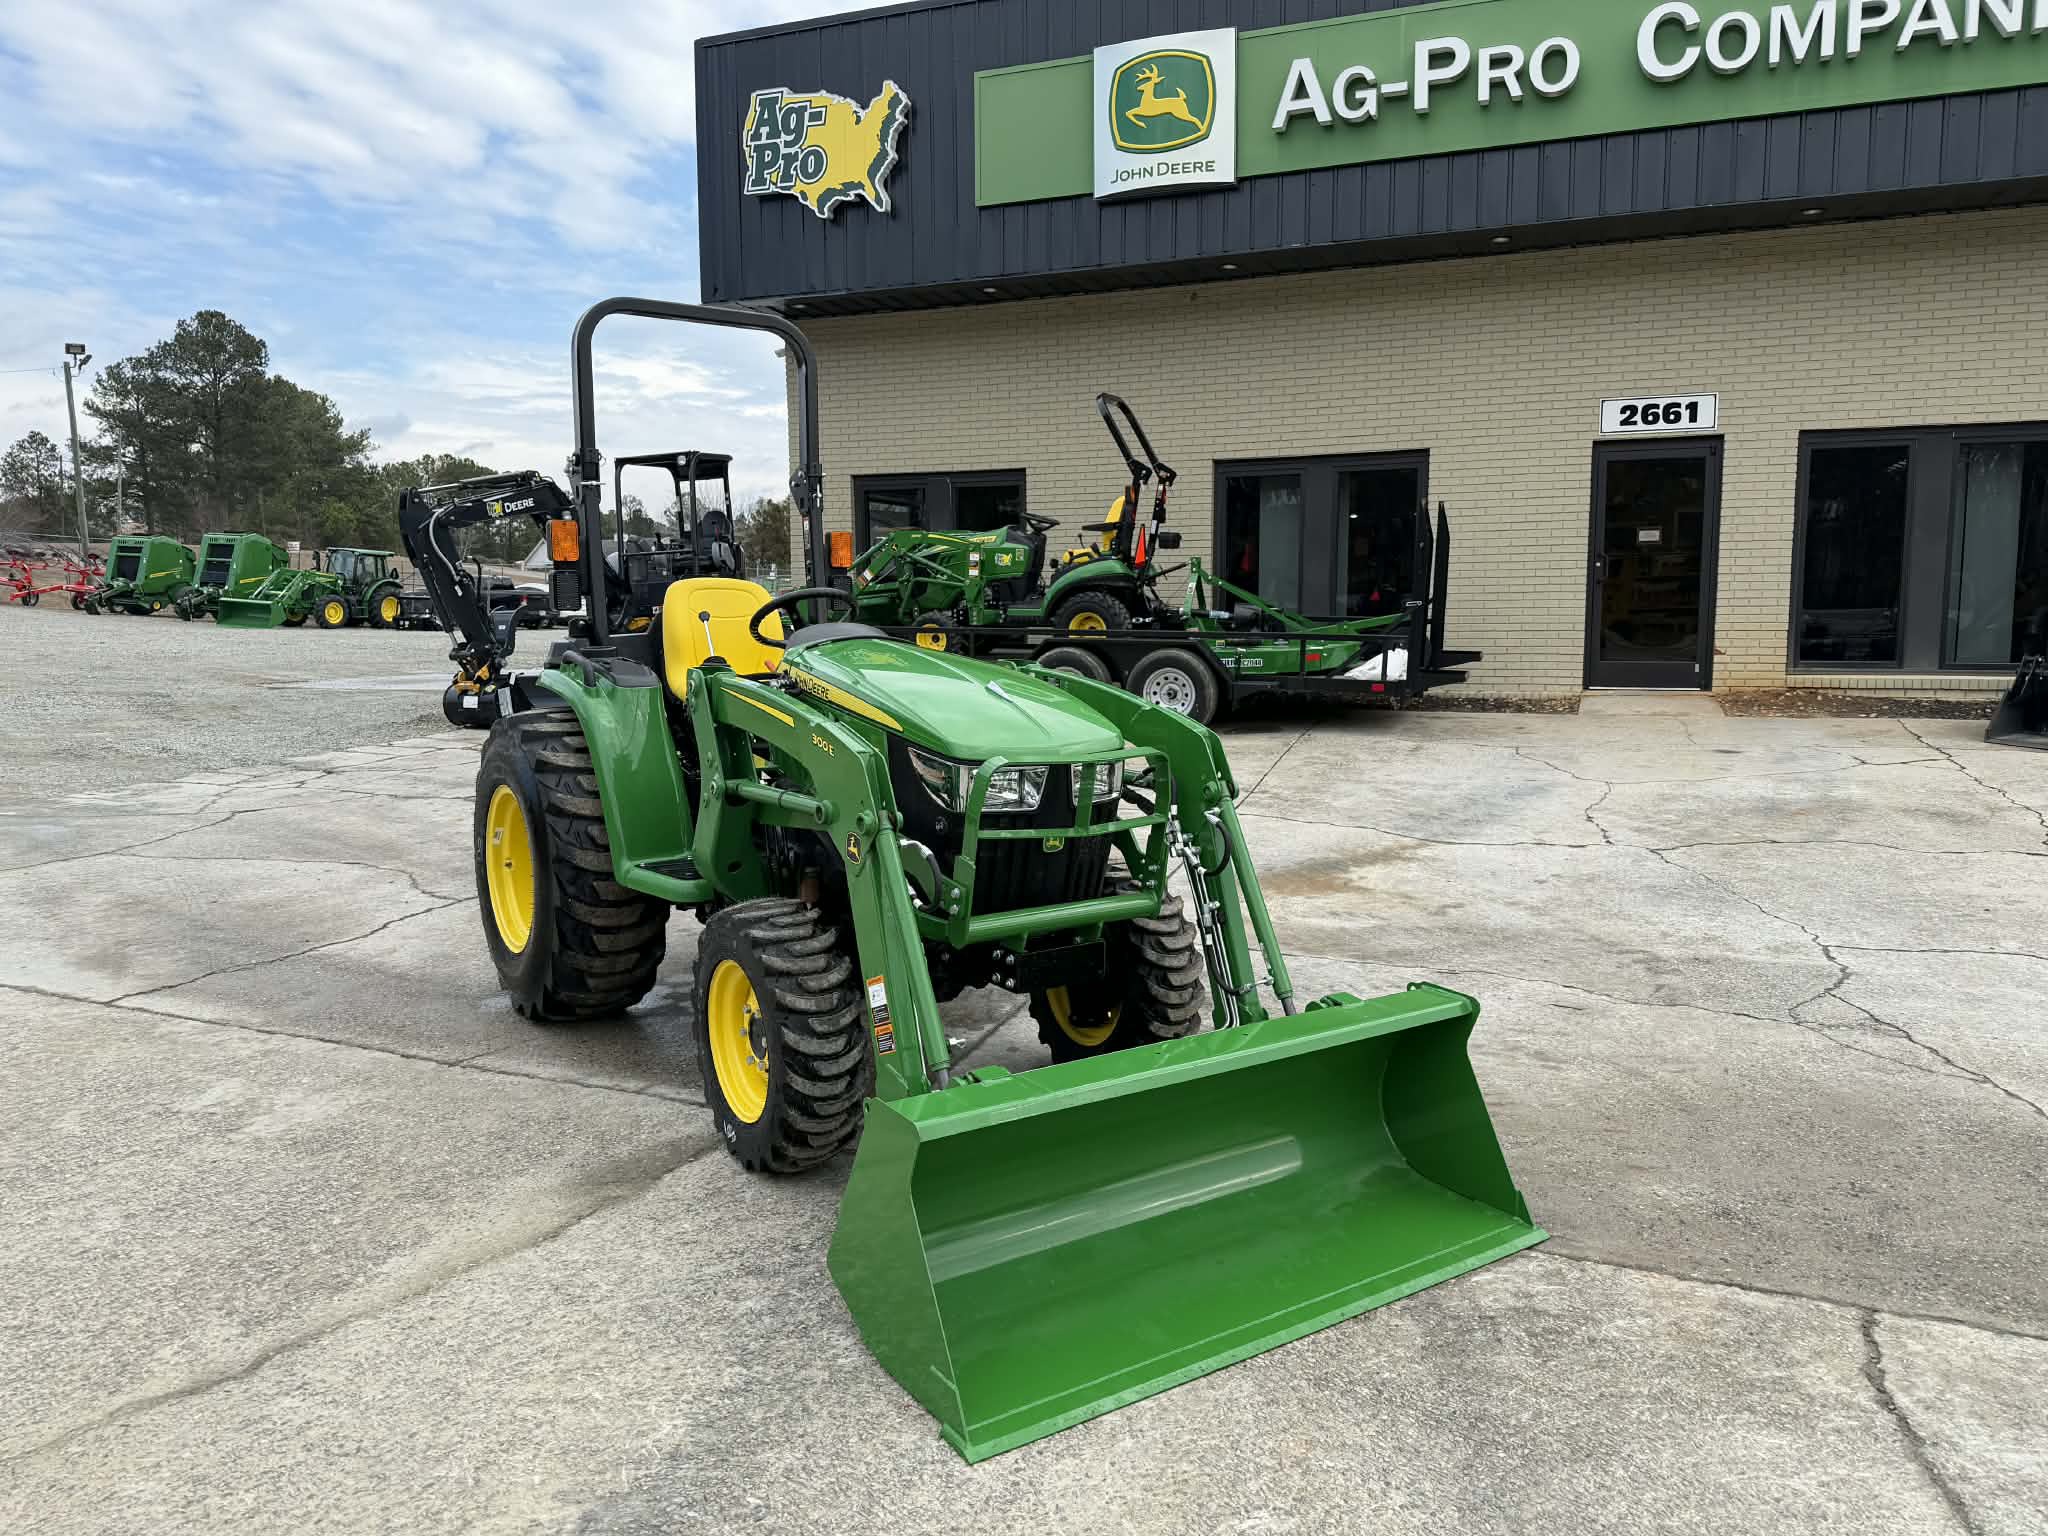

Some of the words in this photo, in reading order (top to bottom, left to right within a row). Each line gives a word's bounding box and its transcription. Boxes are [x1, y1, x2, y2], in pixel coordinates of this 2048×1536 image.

[749, 92, 826, 150] Ag-
[749, 142, 828, 190] Pro
[1110, 167, 1154, 184] JOHN
[1157, 160, 1216, 177] DEERE
[1619, 401, 1698, 426] 2661
[504, 498, 535, 513] DEERE
[811, 733, 835, 757] 300E
